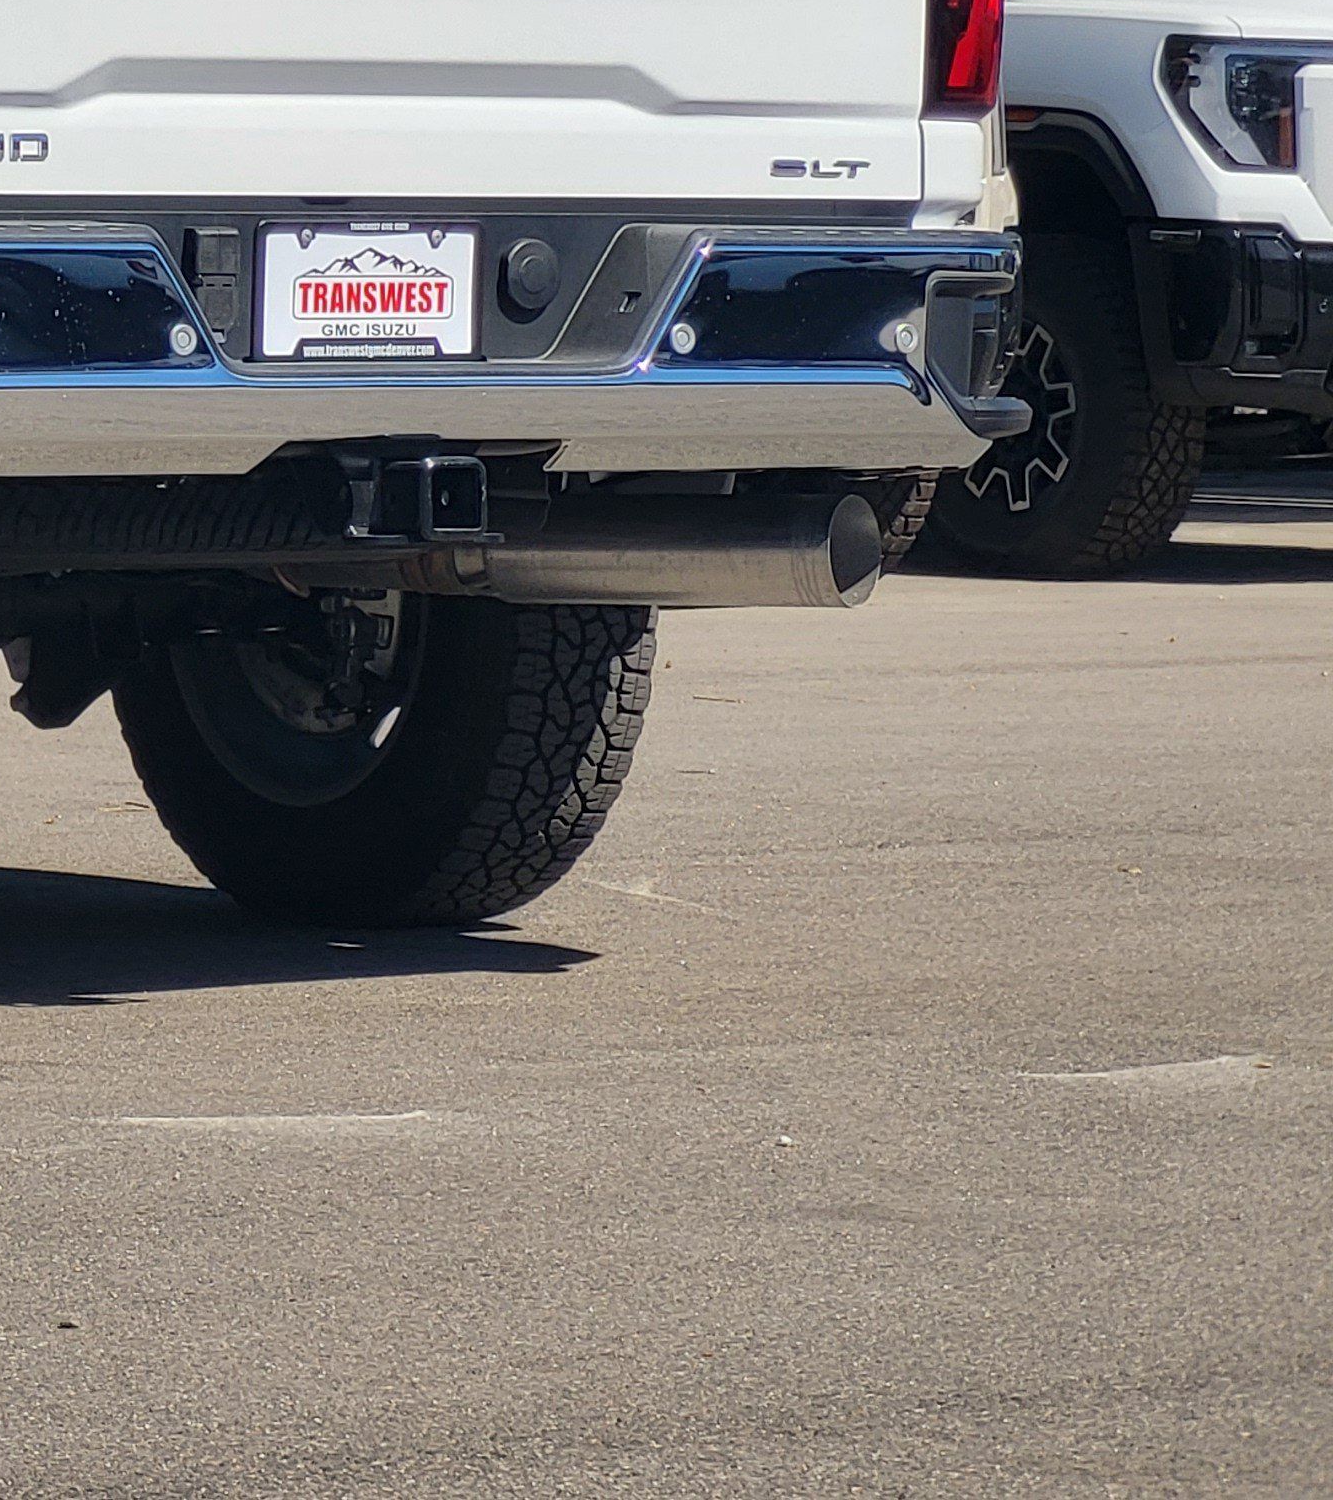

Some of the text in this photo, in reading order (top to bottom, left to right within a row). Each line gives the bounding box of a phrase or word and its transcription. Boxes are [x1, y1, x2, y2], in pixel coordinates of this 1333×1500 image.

[770, 159, 871, 179] SLT
[299, 282, 448, 314] TRANSWEST
[322, 324, 417, 337] GMC ISUZU
